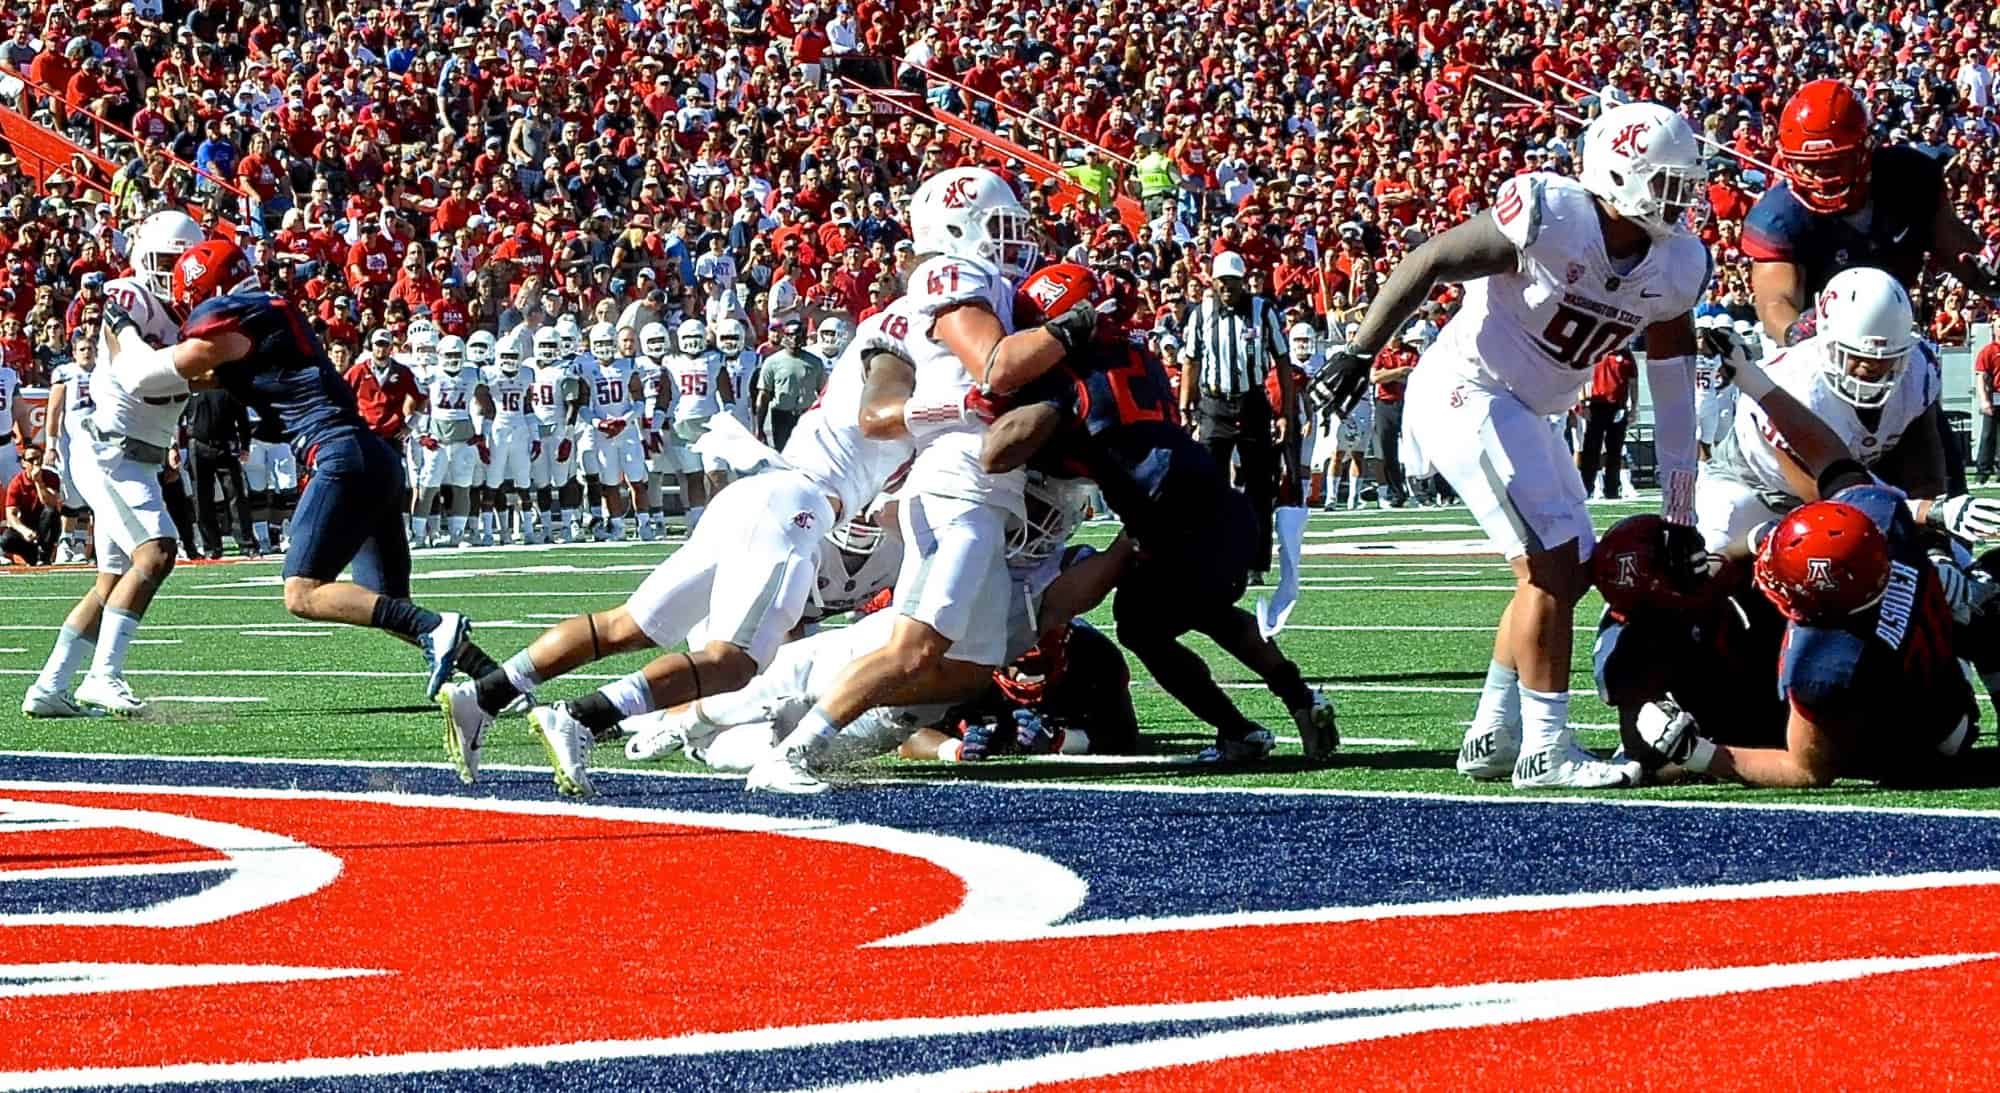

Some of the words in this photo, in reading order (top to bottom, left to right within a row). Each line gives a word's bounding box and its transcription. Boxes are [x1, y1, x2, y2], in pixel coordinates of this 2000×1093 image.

[928, 264, 959, 295] 47
[880, 313, 909, 340] 18
[1534, 302, 1635, 371] 90
[595, 379, 624, 405] 50
[681, 374, 708, 398] 95
[438, 392, 466, 410] 44
[502, 392, 521, 411] 16
[1461, 732, 1497, 763] NIKE
[1516, 751, 1548, 780] NIKE
